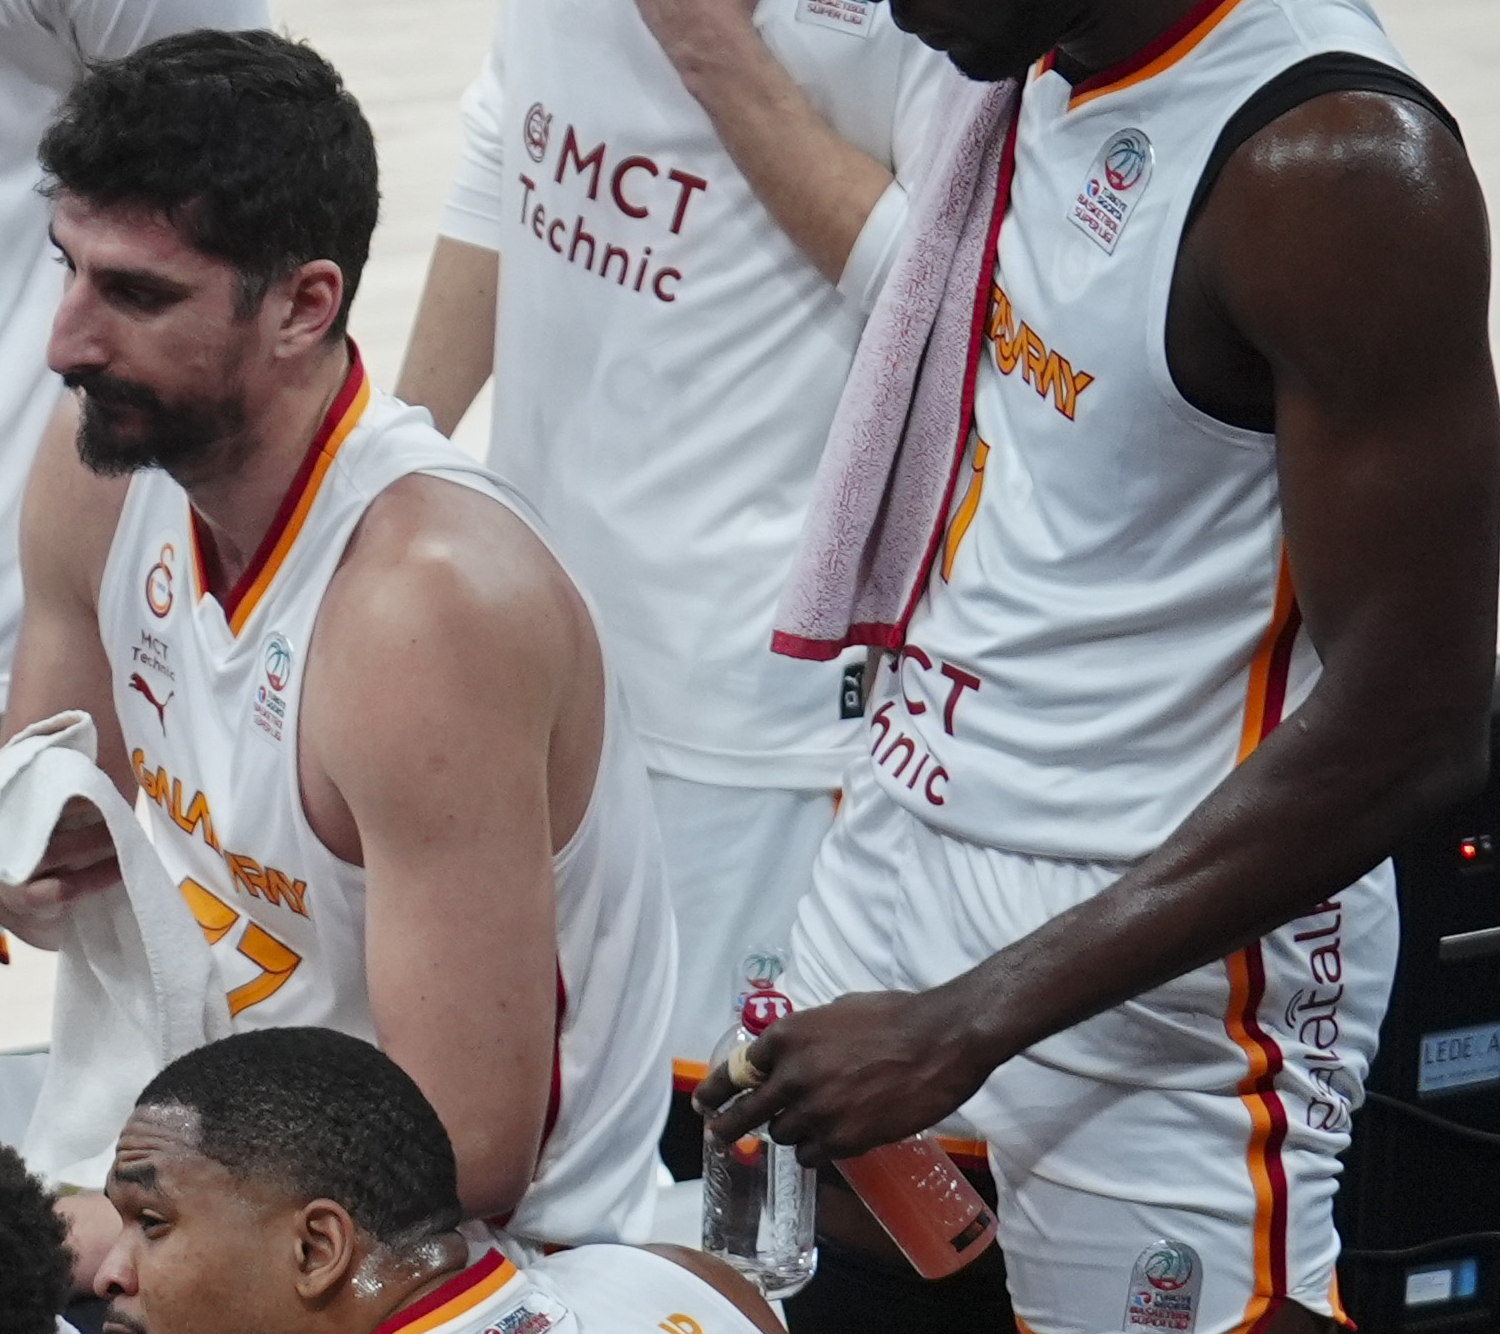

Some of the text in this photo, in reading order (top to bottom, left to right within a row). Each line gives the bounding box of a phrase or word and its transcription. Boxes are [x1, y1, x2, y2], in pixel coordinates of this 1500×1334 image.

[554, 124, 707, 236] MCT
[519, 173, 682, 303] Technic
[141, 629, 169, 660] MCT
[892, 644, 981, 736] CT
[871, 701, 950, 806] hnic
[1425, 1029, 1500, 1064] LEDEA
